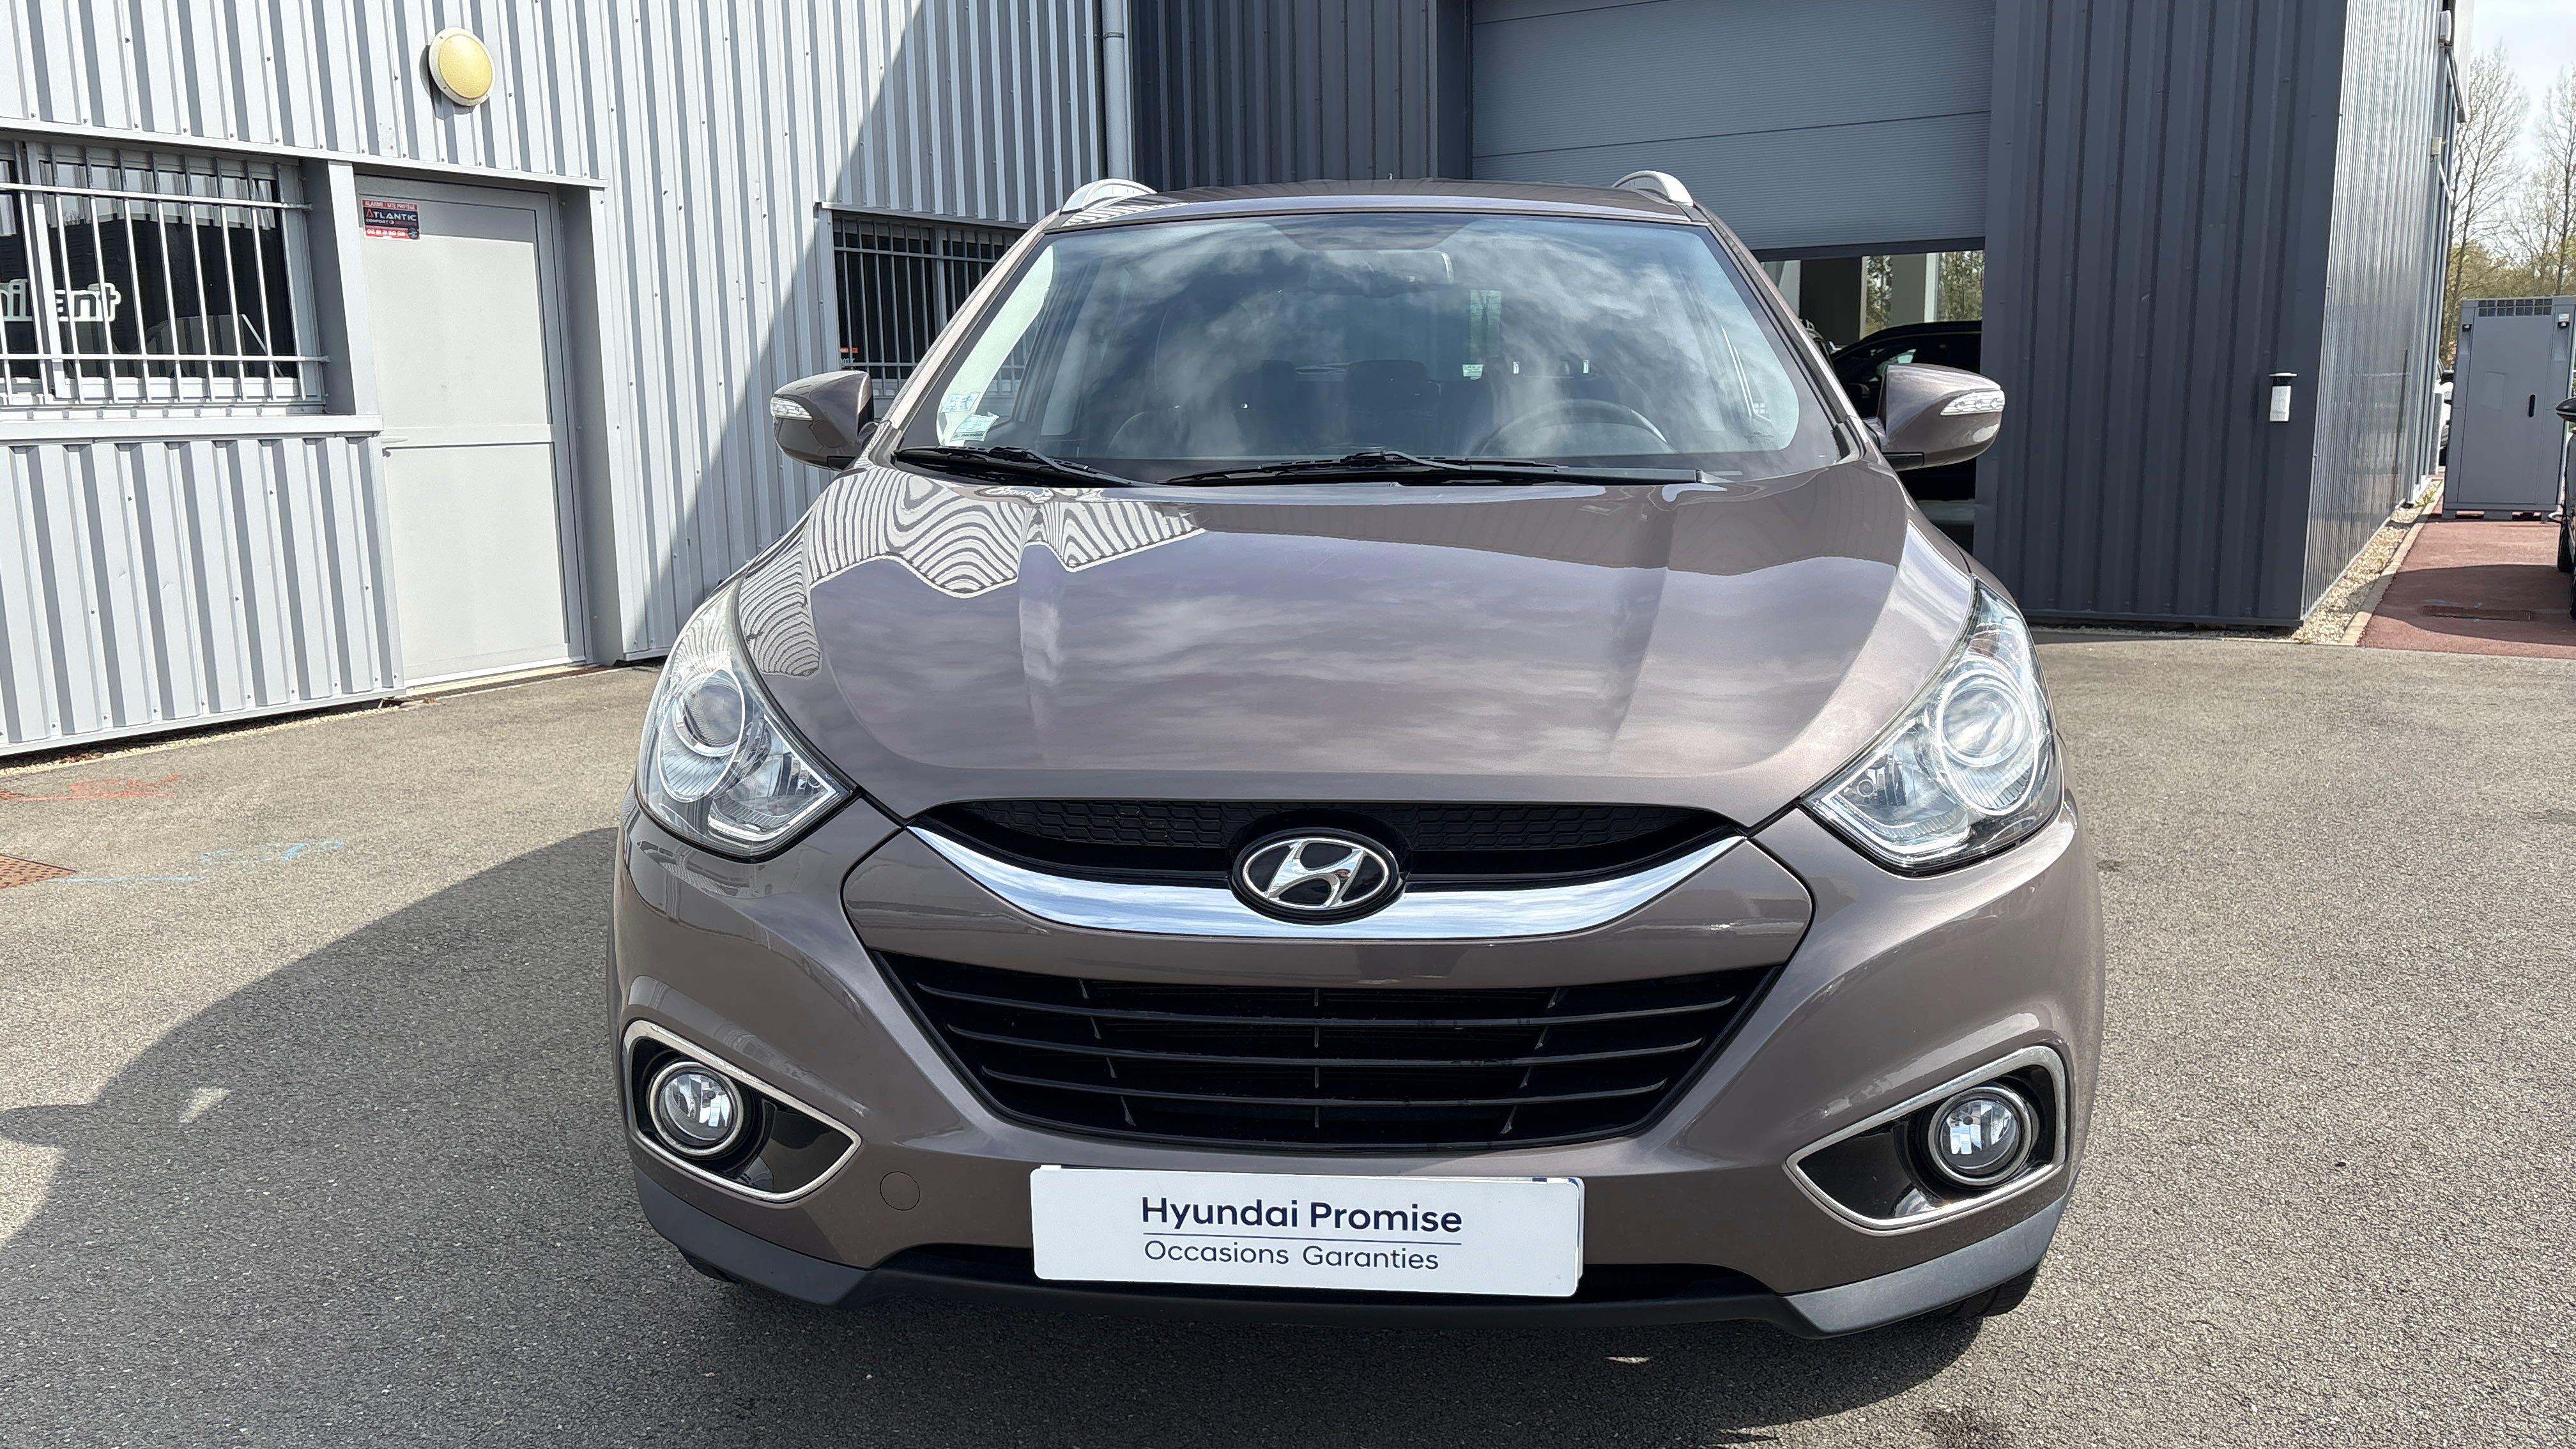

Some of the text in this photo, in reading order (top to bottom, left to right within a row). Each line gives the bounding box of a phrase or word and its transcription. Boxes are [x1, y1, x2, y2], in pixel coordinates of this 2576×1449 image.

[365, 208, 417, 221] ATLANTIC
[1142, 1197, 1462, 1233] Hyundai Promise
[1144, 1240, 1439, 1269] Occasions Garanties
